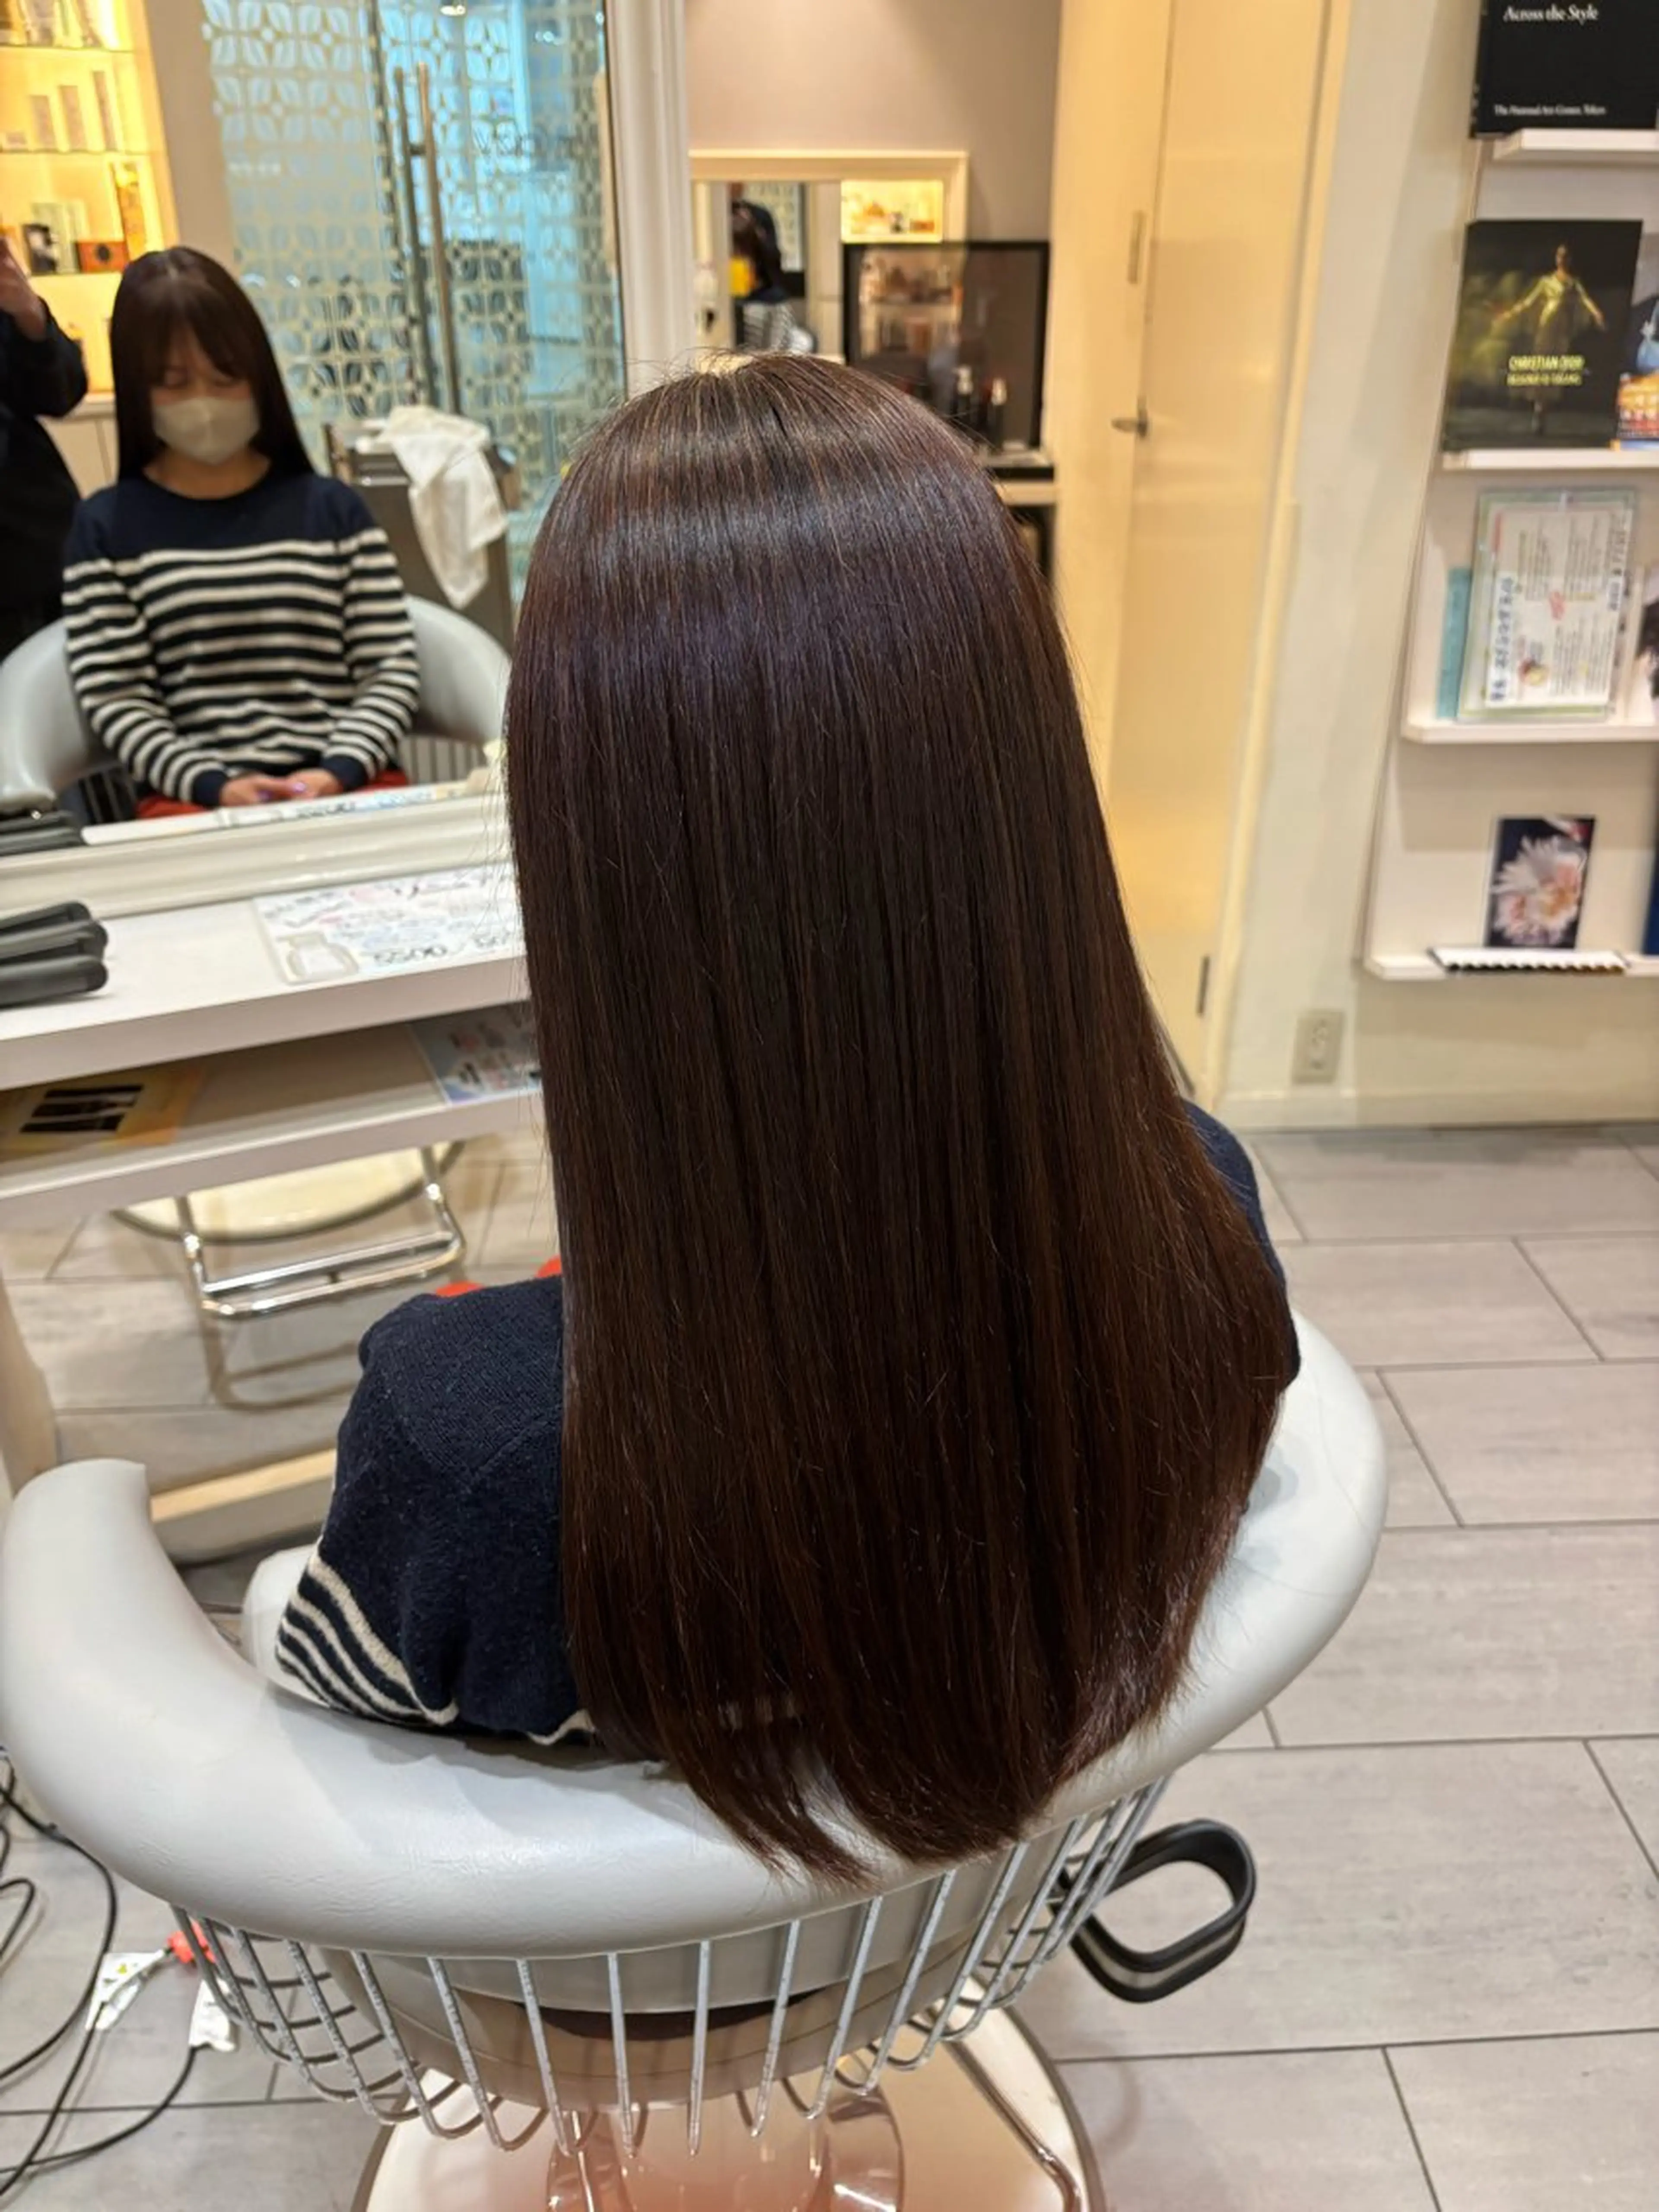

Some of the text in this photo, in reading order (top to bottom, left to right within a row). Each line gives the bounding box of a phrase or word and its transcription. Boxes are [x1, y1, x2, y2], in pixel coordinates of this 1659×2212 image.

[1503, 3, 1599, 25] Across the Style
